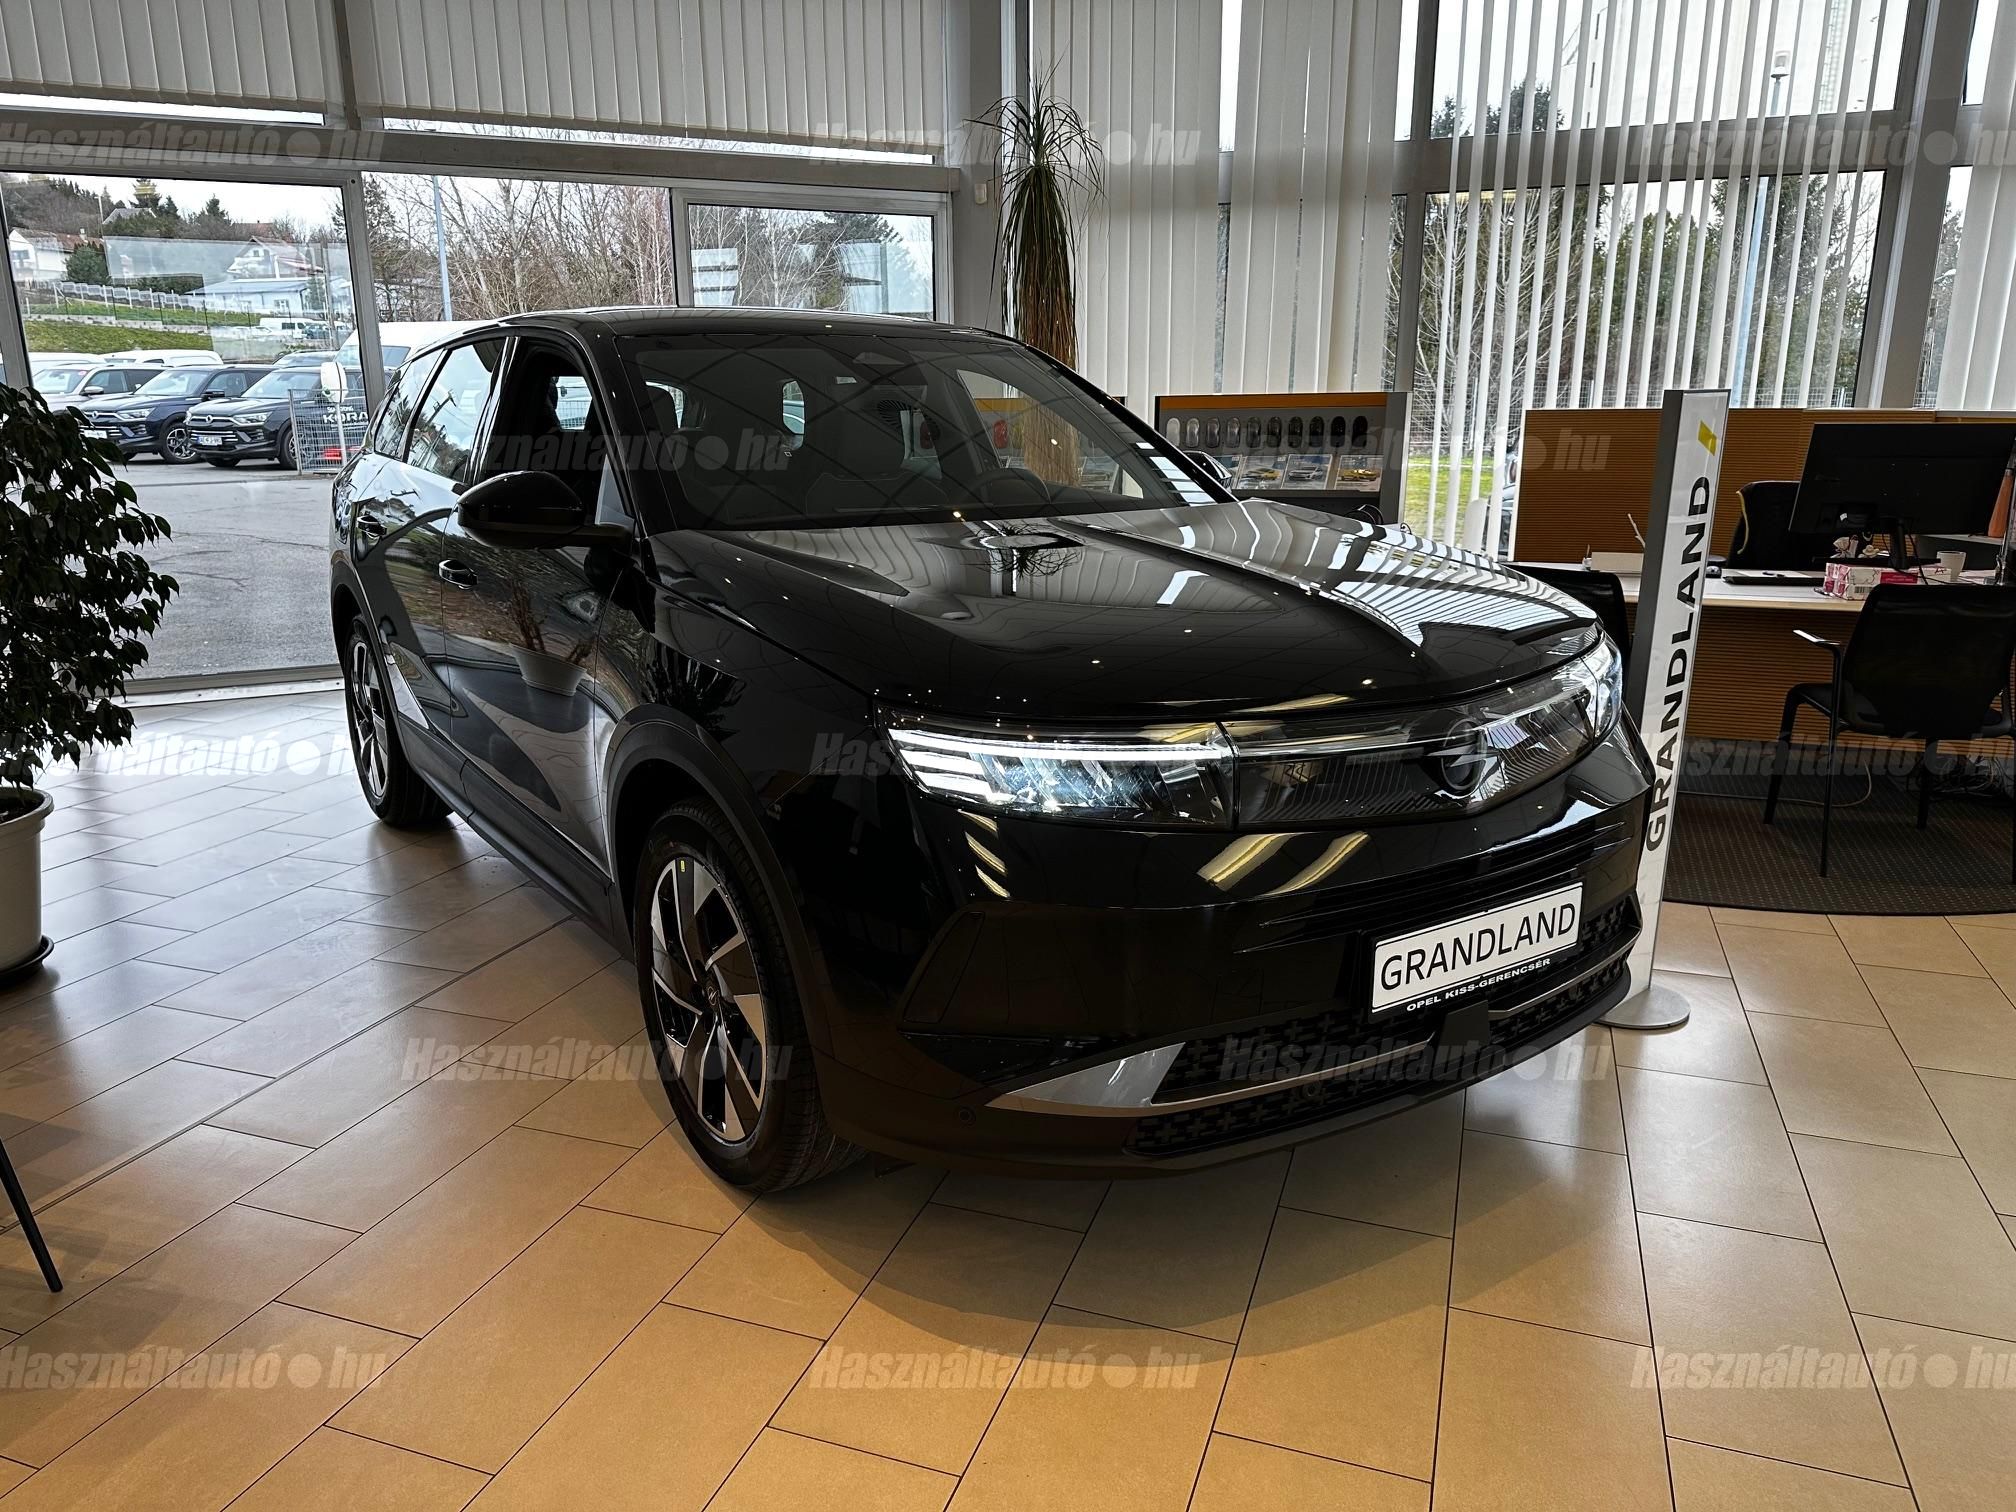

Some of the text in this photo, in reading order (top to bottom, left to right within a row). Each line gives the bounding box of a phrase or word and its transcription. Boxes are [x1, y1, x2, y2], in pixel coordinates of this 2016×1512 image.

[1645, 475, 1711, 853] GRANDLAND
[1380, 902, 1577, 991] GRANDLAND
[1406, 957, 1551, 1012] OPEL KISS-GERENCSÉR
